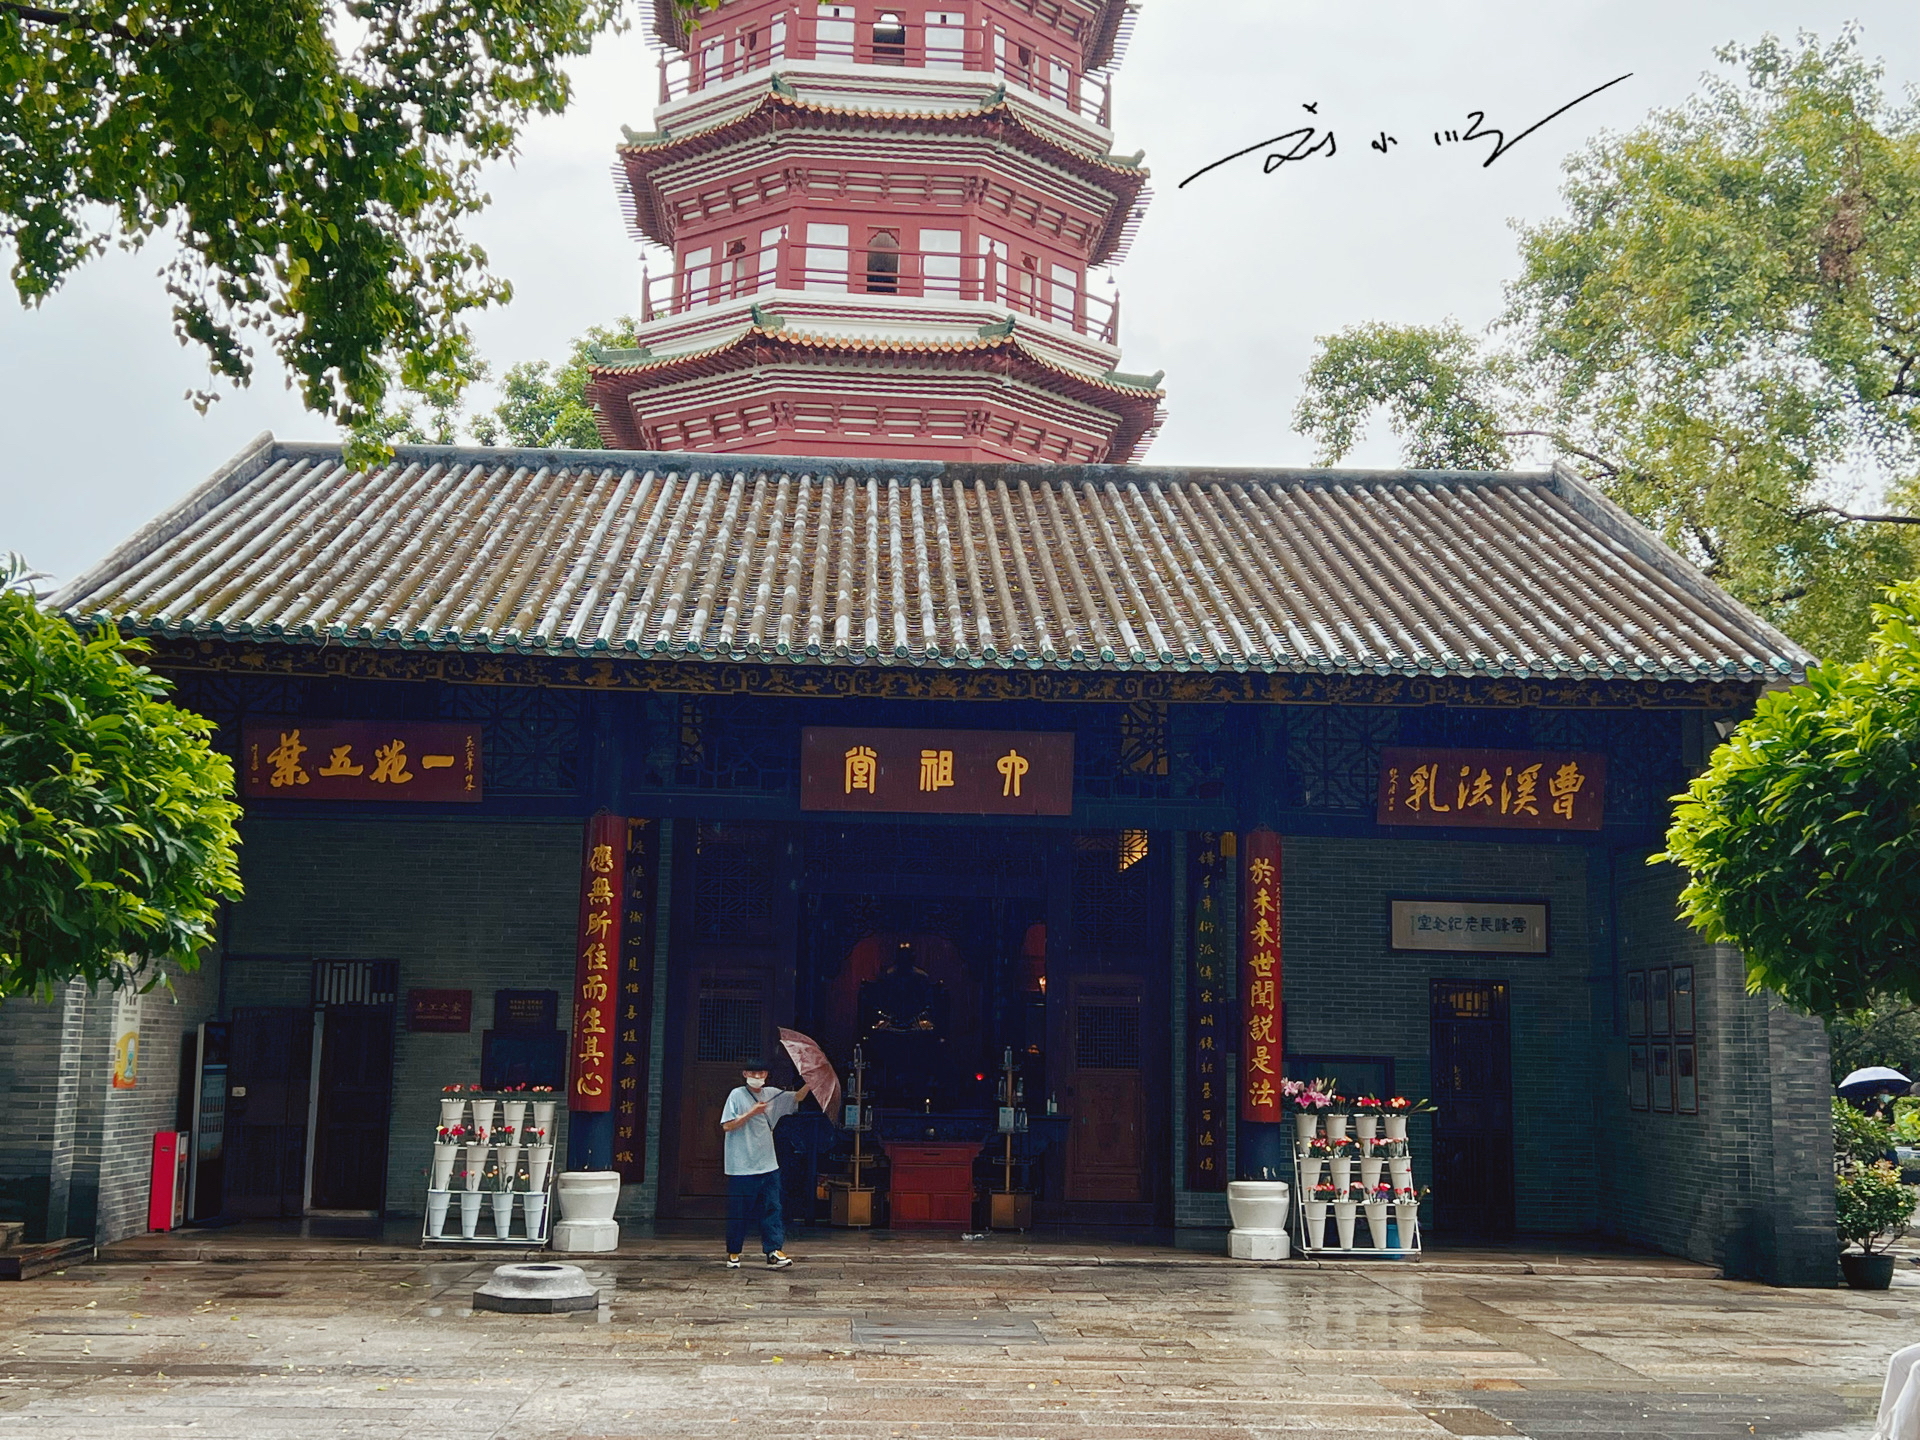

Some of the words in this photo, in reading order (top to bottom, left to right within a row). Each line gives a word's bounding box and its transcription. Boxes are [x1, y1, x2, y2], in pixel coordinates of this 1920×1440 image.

[266, 728, 455, 787] 一花五葉
[844, 745, 1029, 797] 六祖堂
[1404, 761, 1585, 820] 曹溪法乳
